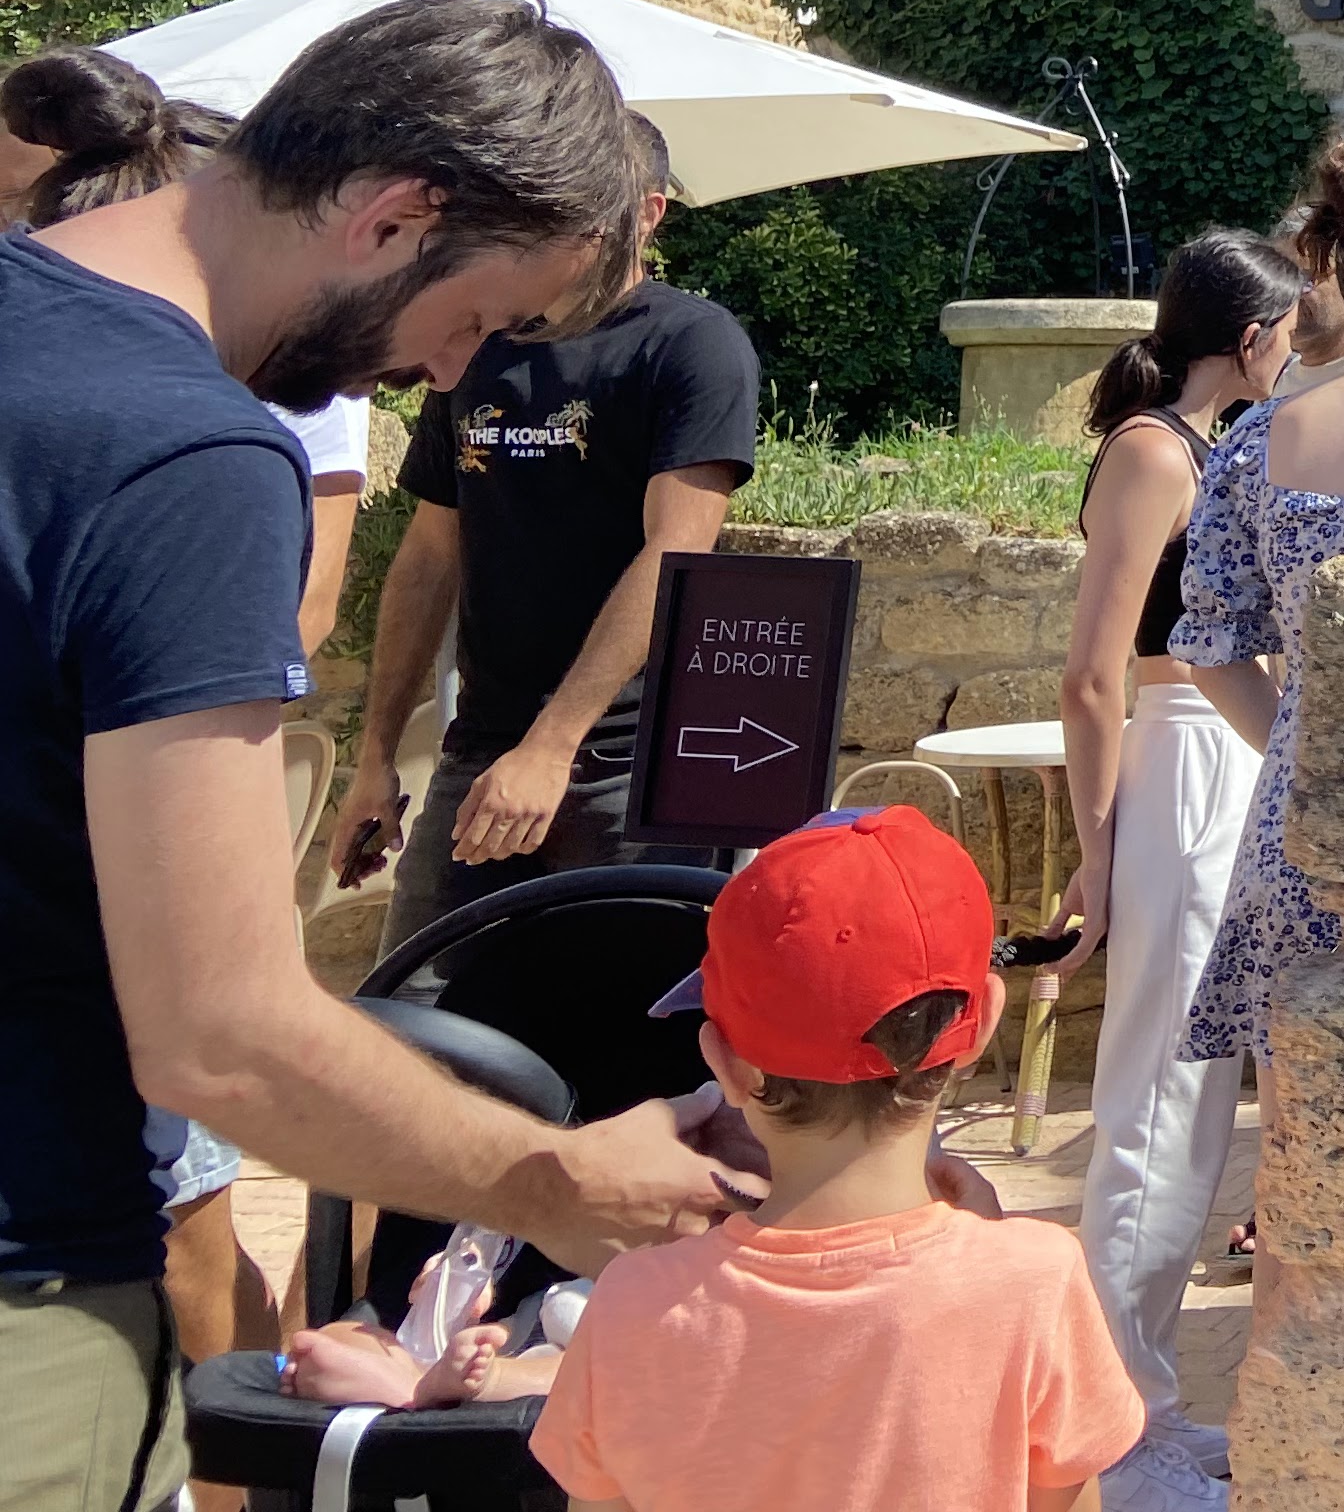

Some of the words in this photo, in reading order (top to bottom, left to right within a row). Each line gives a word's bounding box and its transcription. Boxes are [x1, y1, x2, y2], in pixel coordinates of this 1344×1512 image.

[468, 427, 500, 445] THE
[510, 448, 546, 458] PARIS
[702, 614, 806, 646] ENTRÉE
[687, 645, 704, 673] À
[713, 651, 813, 678] DROITE
